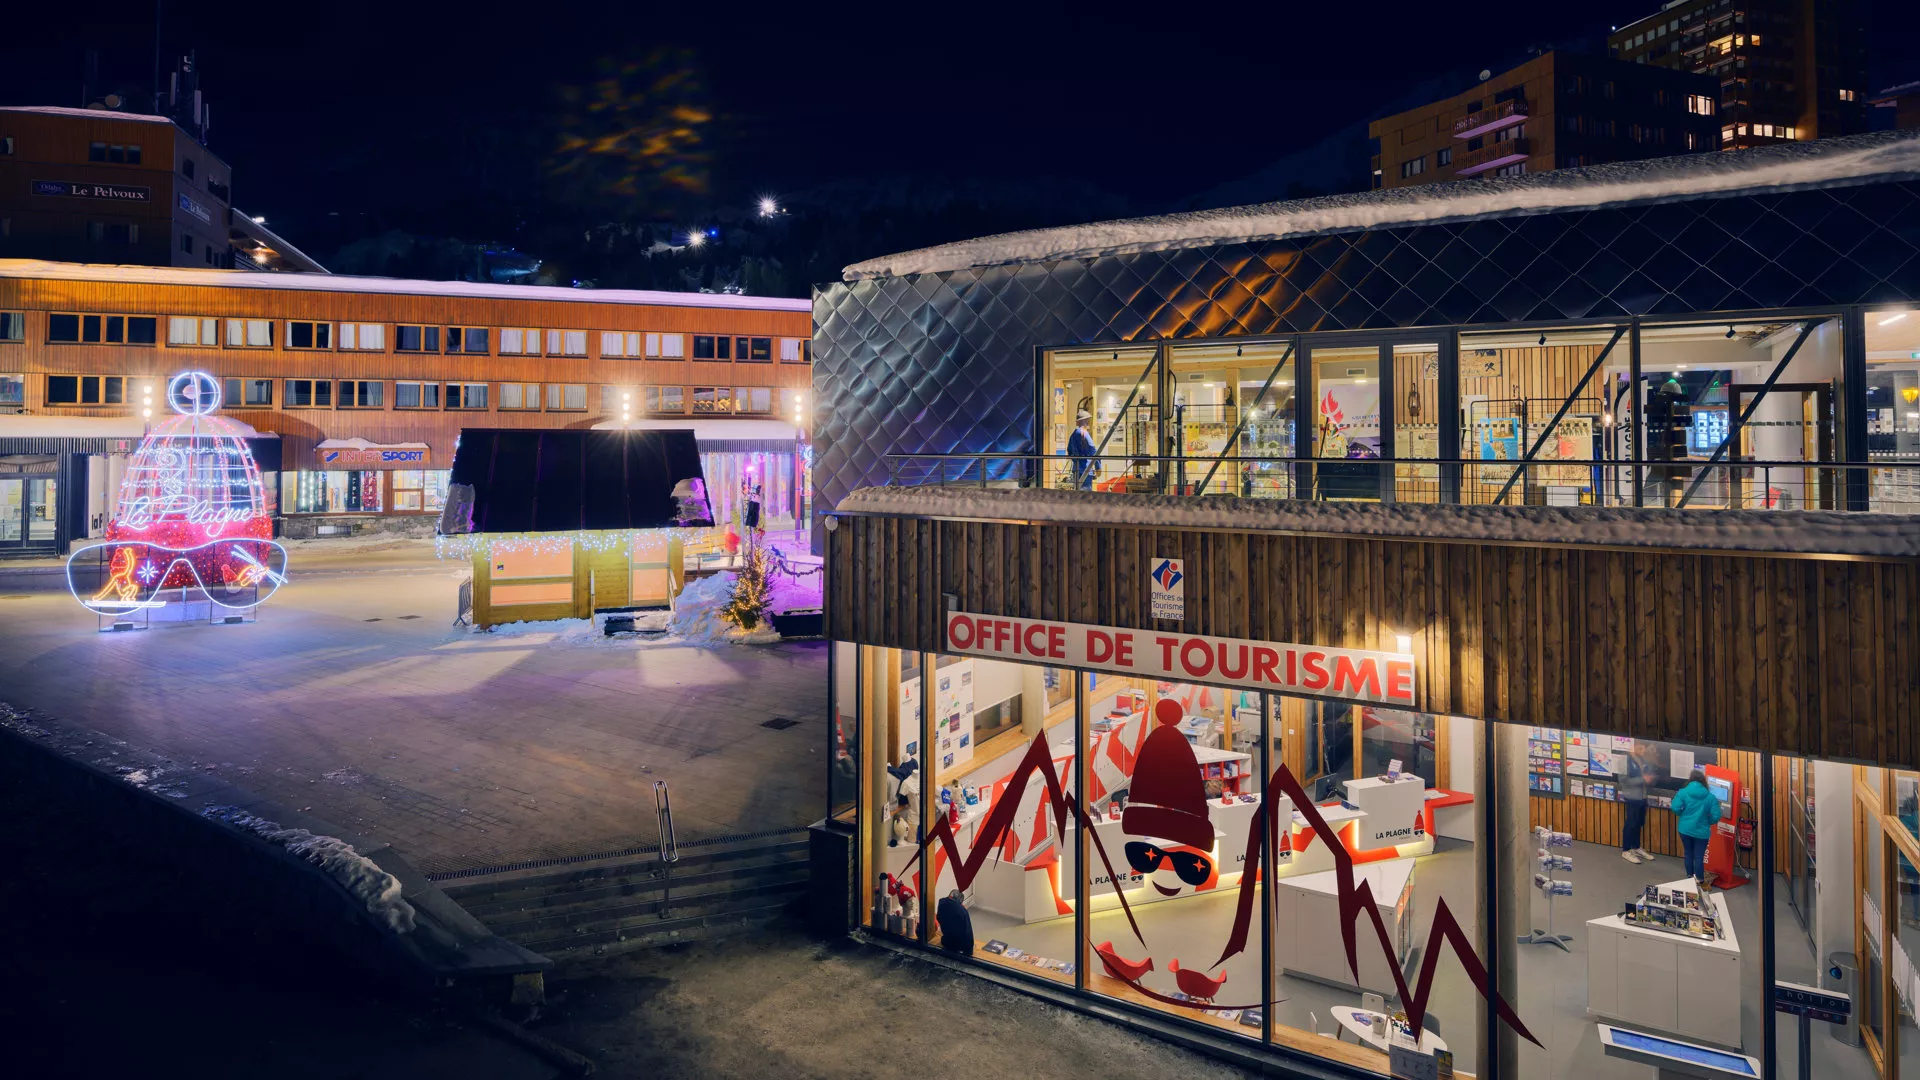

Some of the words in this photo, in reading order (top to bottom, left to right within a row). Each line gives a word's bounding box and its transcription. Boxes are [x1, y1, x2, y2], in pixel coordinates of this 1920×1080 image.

[71, 184, 88, 196] Le
[94, 186, 145, 199] Pelvoux
[341, 450, 424, 462] INTERSPORT
[118, 495, 150, 531] La
[152, 494, 254, 538] Plagne
[1152, 592, 1175, 600] Offices
[1152, 601, 1183, 610] Tourisme
[1160, 610, 1183, 620] France
[948, 614, 1066, 659] OFFICE
[1087, 631, 1134, 667] DE
[1156, 637, 1415, 700] TOURISME
[1385, 828, 1411, 838] PLAGNE
[1095, 873, 1127, 884] PLANE
